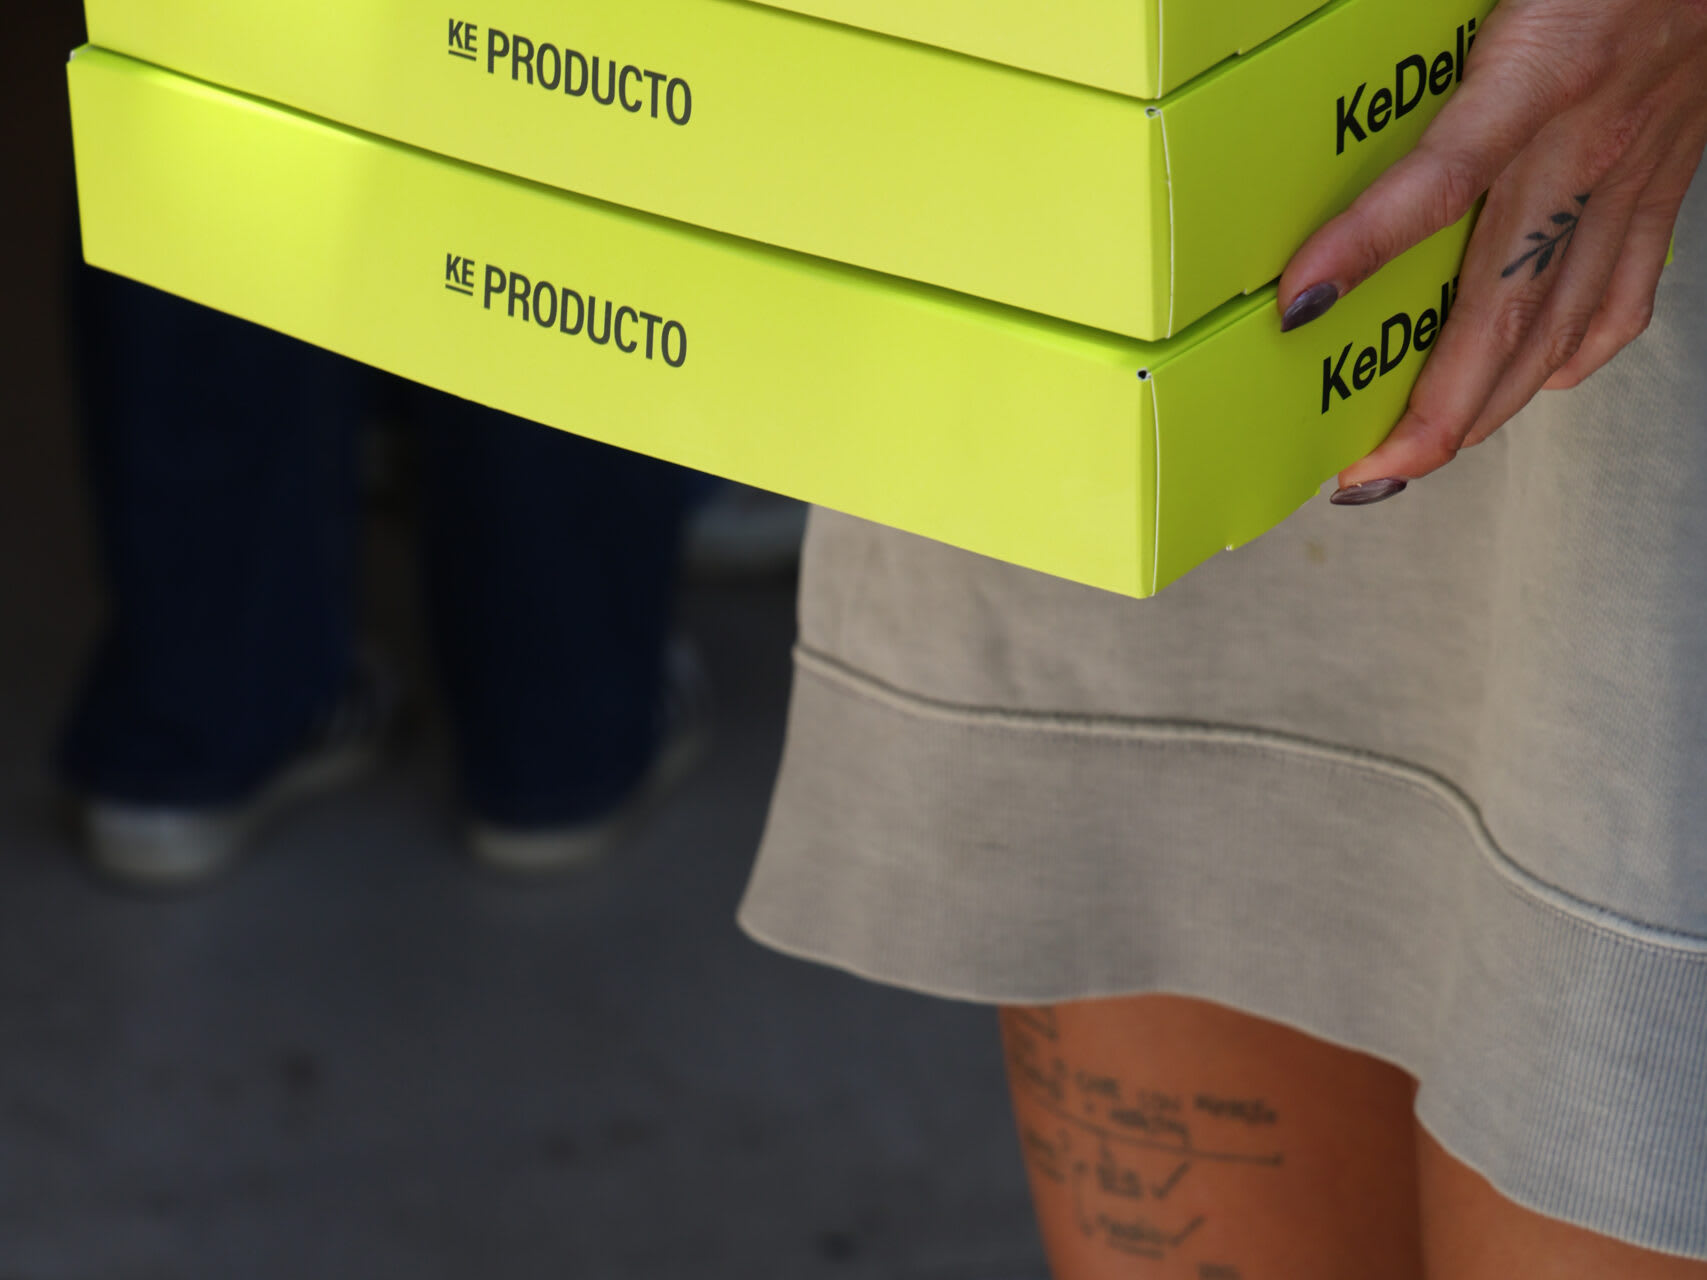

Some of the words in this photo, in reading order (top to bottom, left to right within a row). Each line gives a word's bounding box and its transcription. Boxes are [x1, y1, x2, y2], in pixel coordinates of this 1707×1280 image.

[448, 17, 478, 56] KE
[487, 27, 692, 126] PRODUCTO
[445, 252, 475, 291] KE
[483, 263, 688, 368] PRODUCTO
